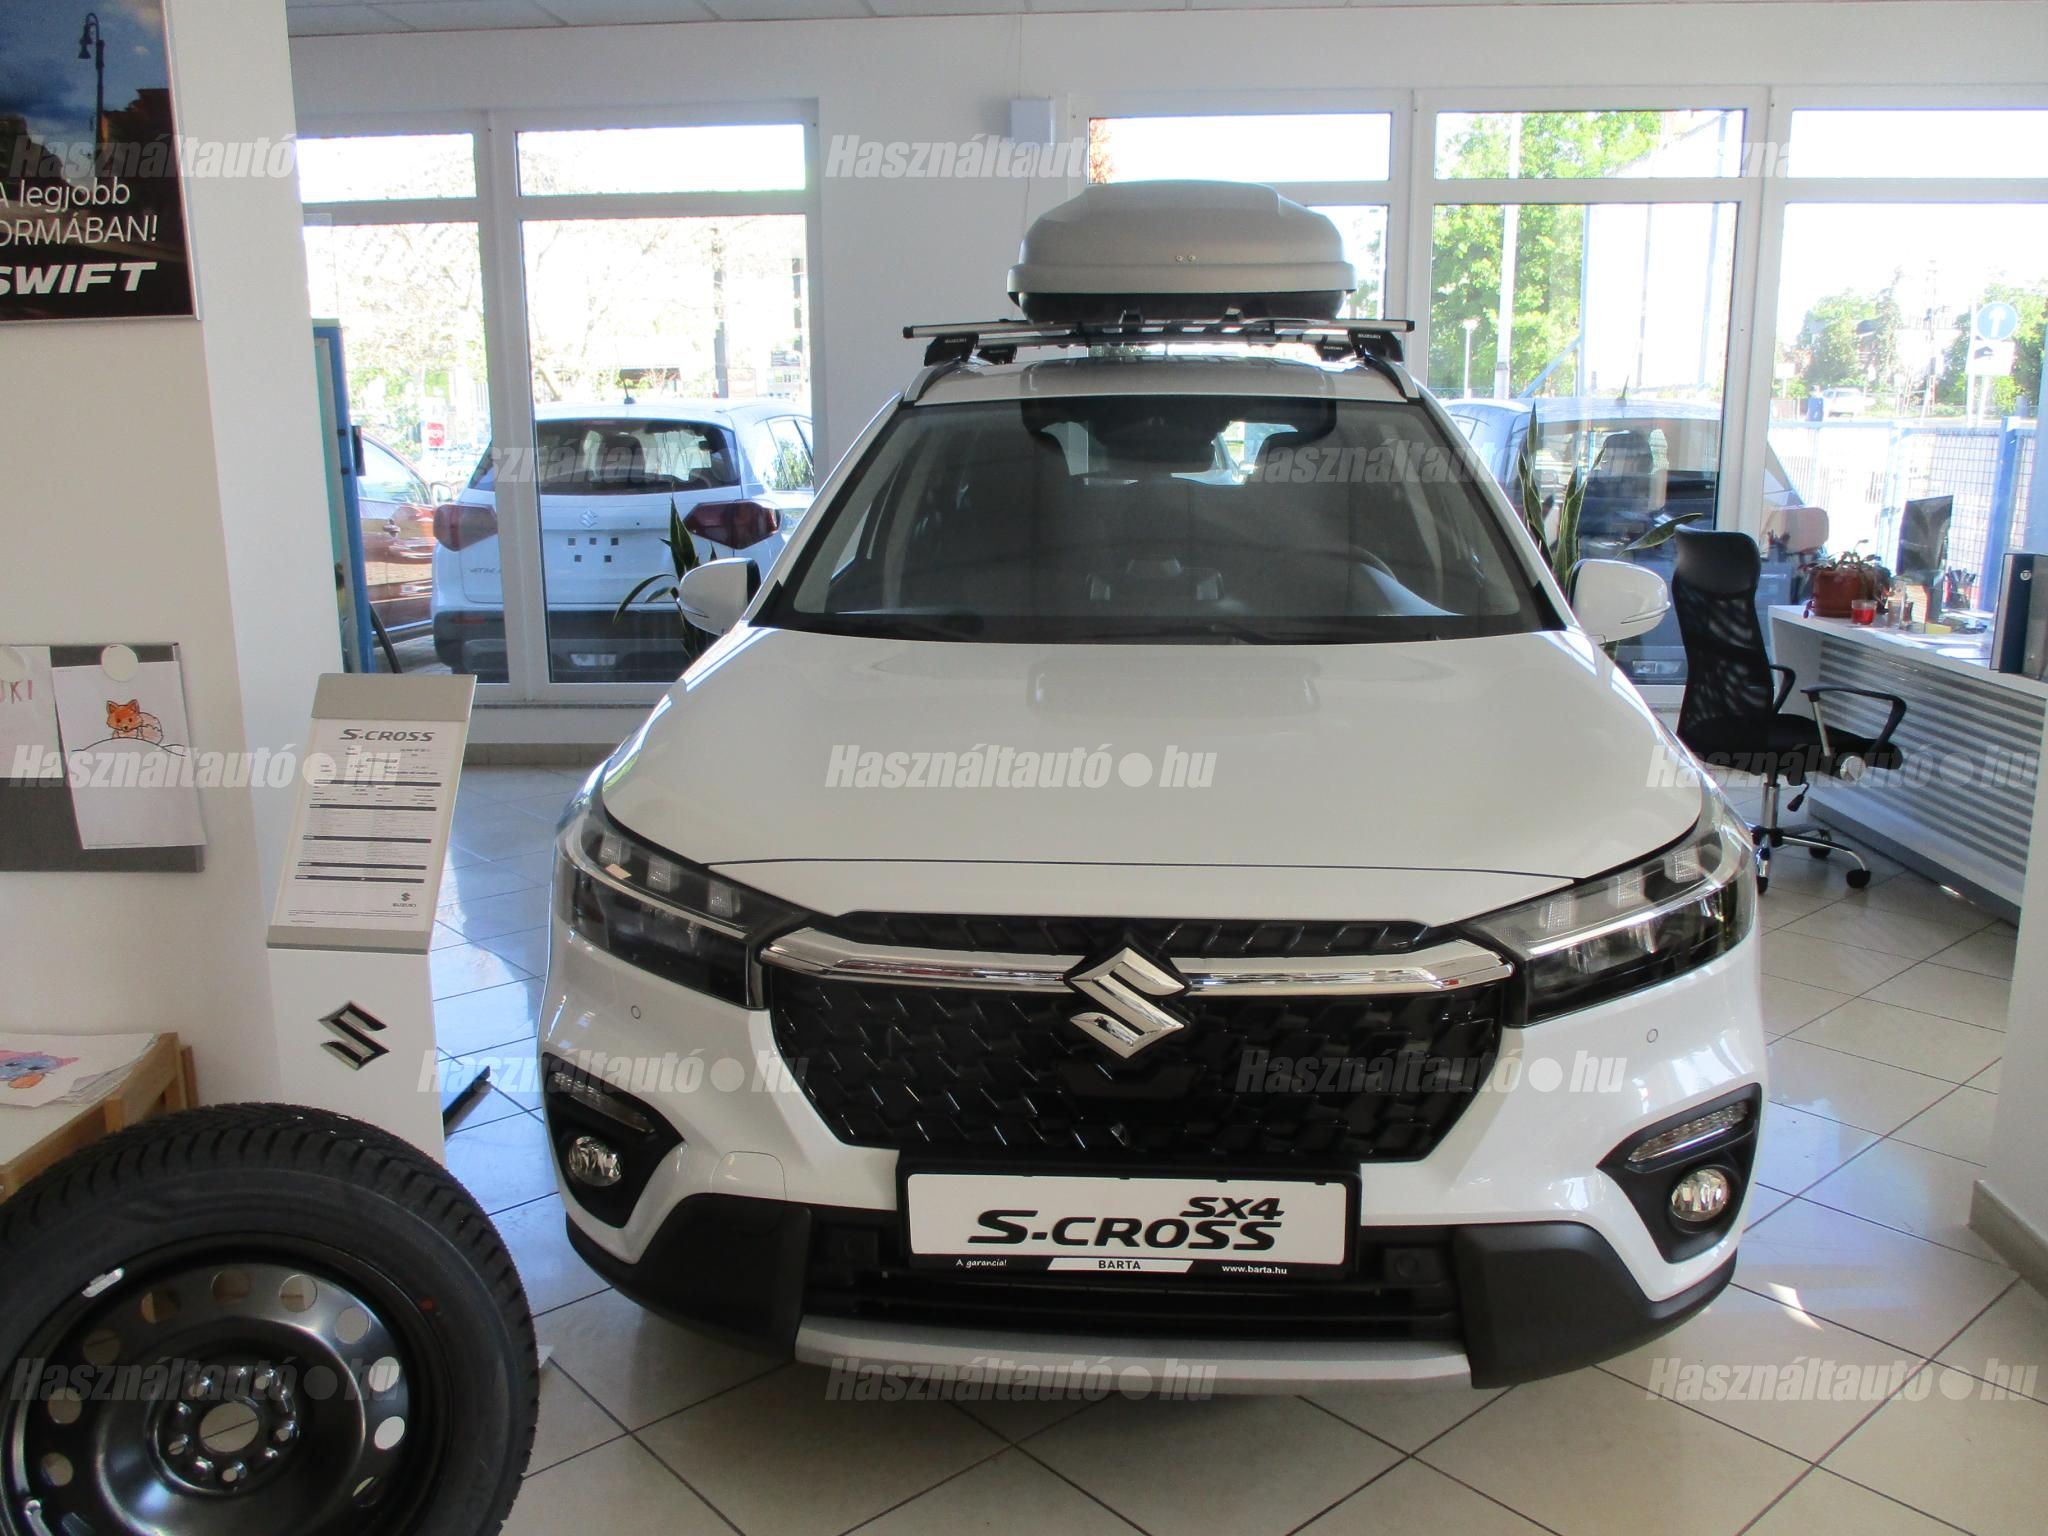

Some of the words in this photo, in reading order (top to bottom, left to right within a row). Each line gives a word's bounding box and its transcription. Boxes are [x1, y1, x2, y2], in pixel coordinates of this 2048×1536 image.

[20, 176, 131, 213] legjobb
[1179, 1197, 1285, 1220] SX4
[967, 1209, 1282, 1251] S-CROSS
[955, 1258, 964, 1267] A
[1098, 1260, 1141, 1270] BARTA
[1222, 1265, 1288, 1275] www.barta.hu
